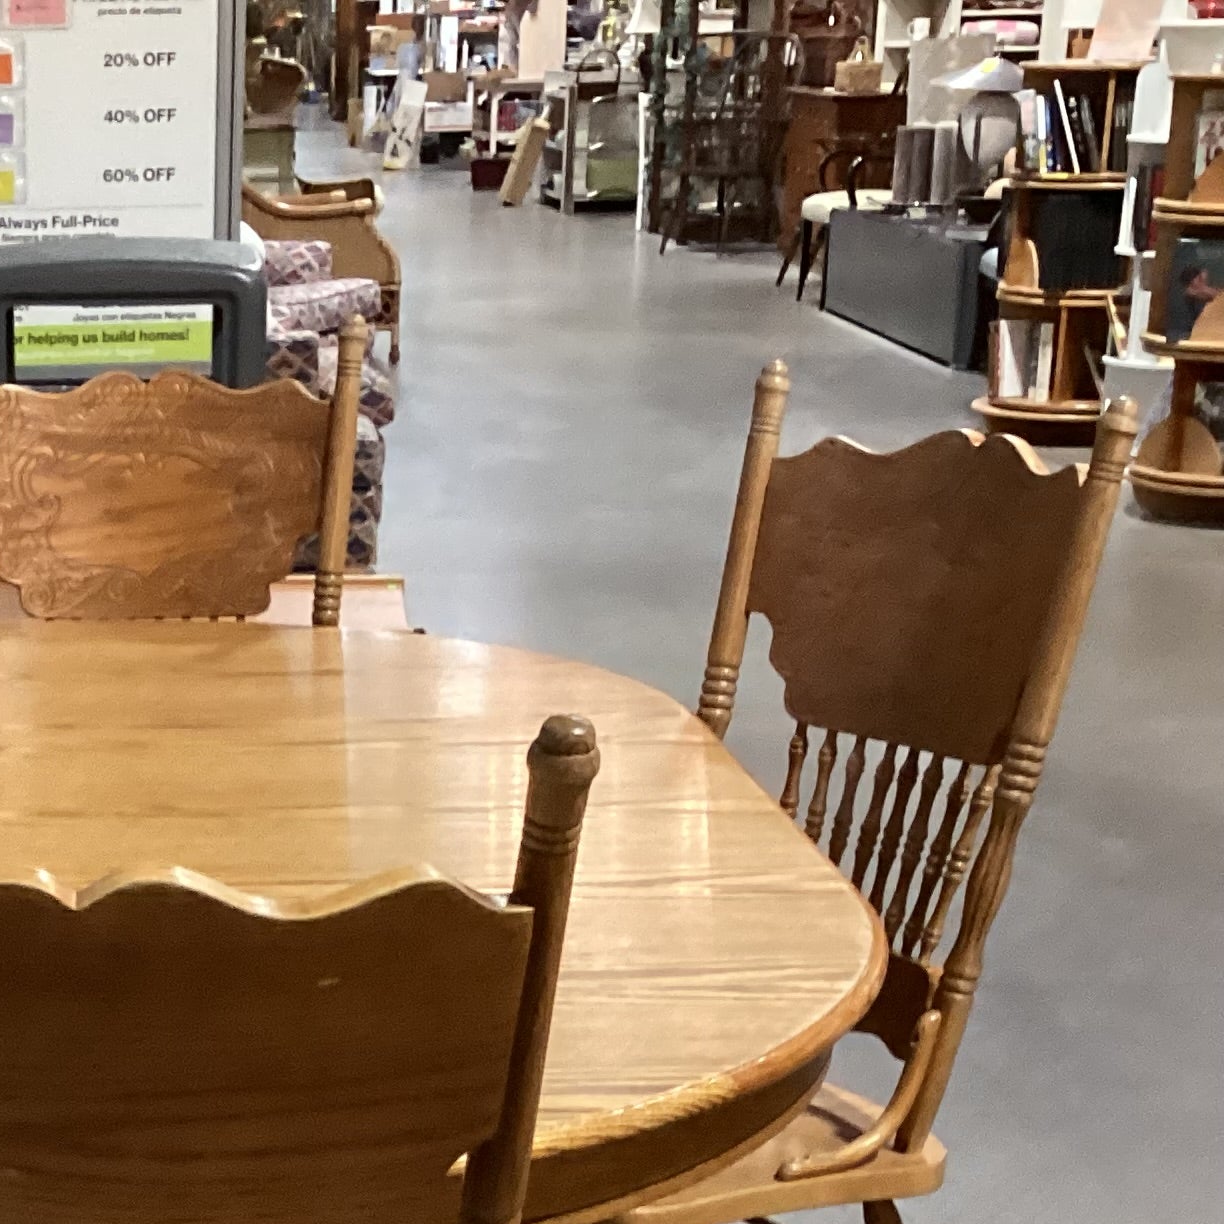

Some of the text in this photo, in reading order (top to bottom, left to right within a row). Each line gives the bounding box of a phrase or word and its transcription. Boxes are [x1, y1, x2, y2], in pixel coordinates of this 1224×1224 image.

[103, 52, 176, 67] 20% OFF
[103, 108, 177, 123] 40% OFF
[103, 168, 175, 182] 60% OFF
[52, 214, 119, 229] Full-Price
[28, 332, 78, 347] helping
[82, 334, 98, 344] us
[102, 330, 136, 343] build
[139, 328, 189, 342] homes!
